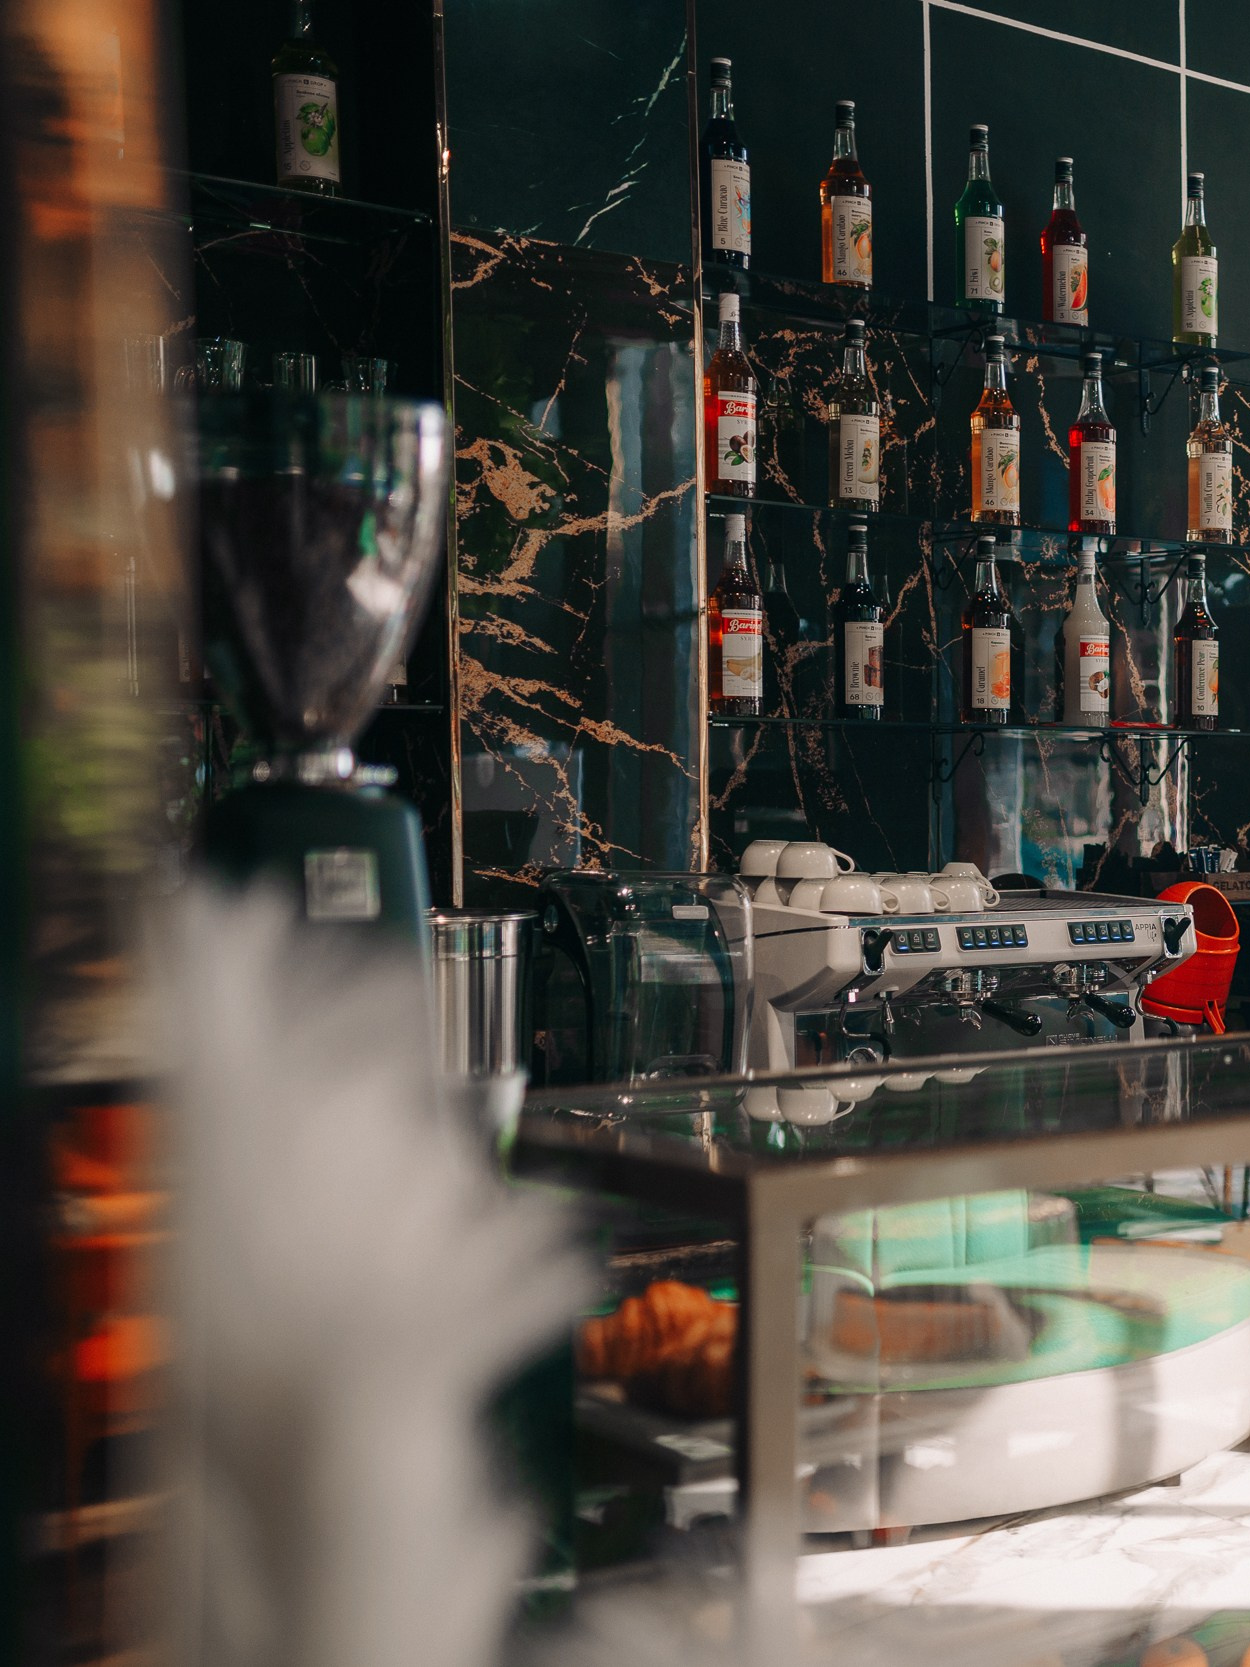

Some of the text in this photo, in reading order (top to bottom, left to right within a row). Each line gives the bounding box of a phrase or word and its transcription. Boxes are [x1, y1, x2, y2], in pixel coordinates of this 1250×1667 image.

[717, 216, 728, 232] Blue
[720, 237, 726, 245] 5
[837, 269, 848, 277] 46
[970, 287, 978, 295] 71
[844, 439, 854, 482] Green Melon
[844, 486, 853, 494] 13
[850, 661, 860, 689] Brownie
[850, 693, 860, 701] 68
[976, 697, 985, 705] 18
[1196, 704, 1205, 712] 10
[1135, 923, 1157, 931] APPIA
